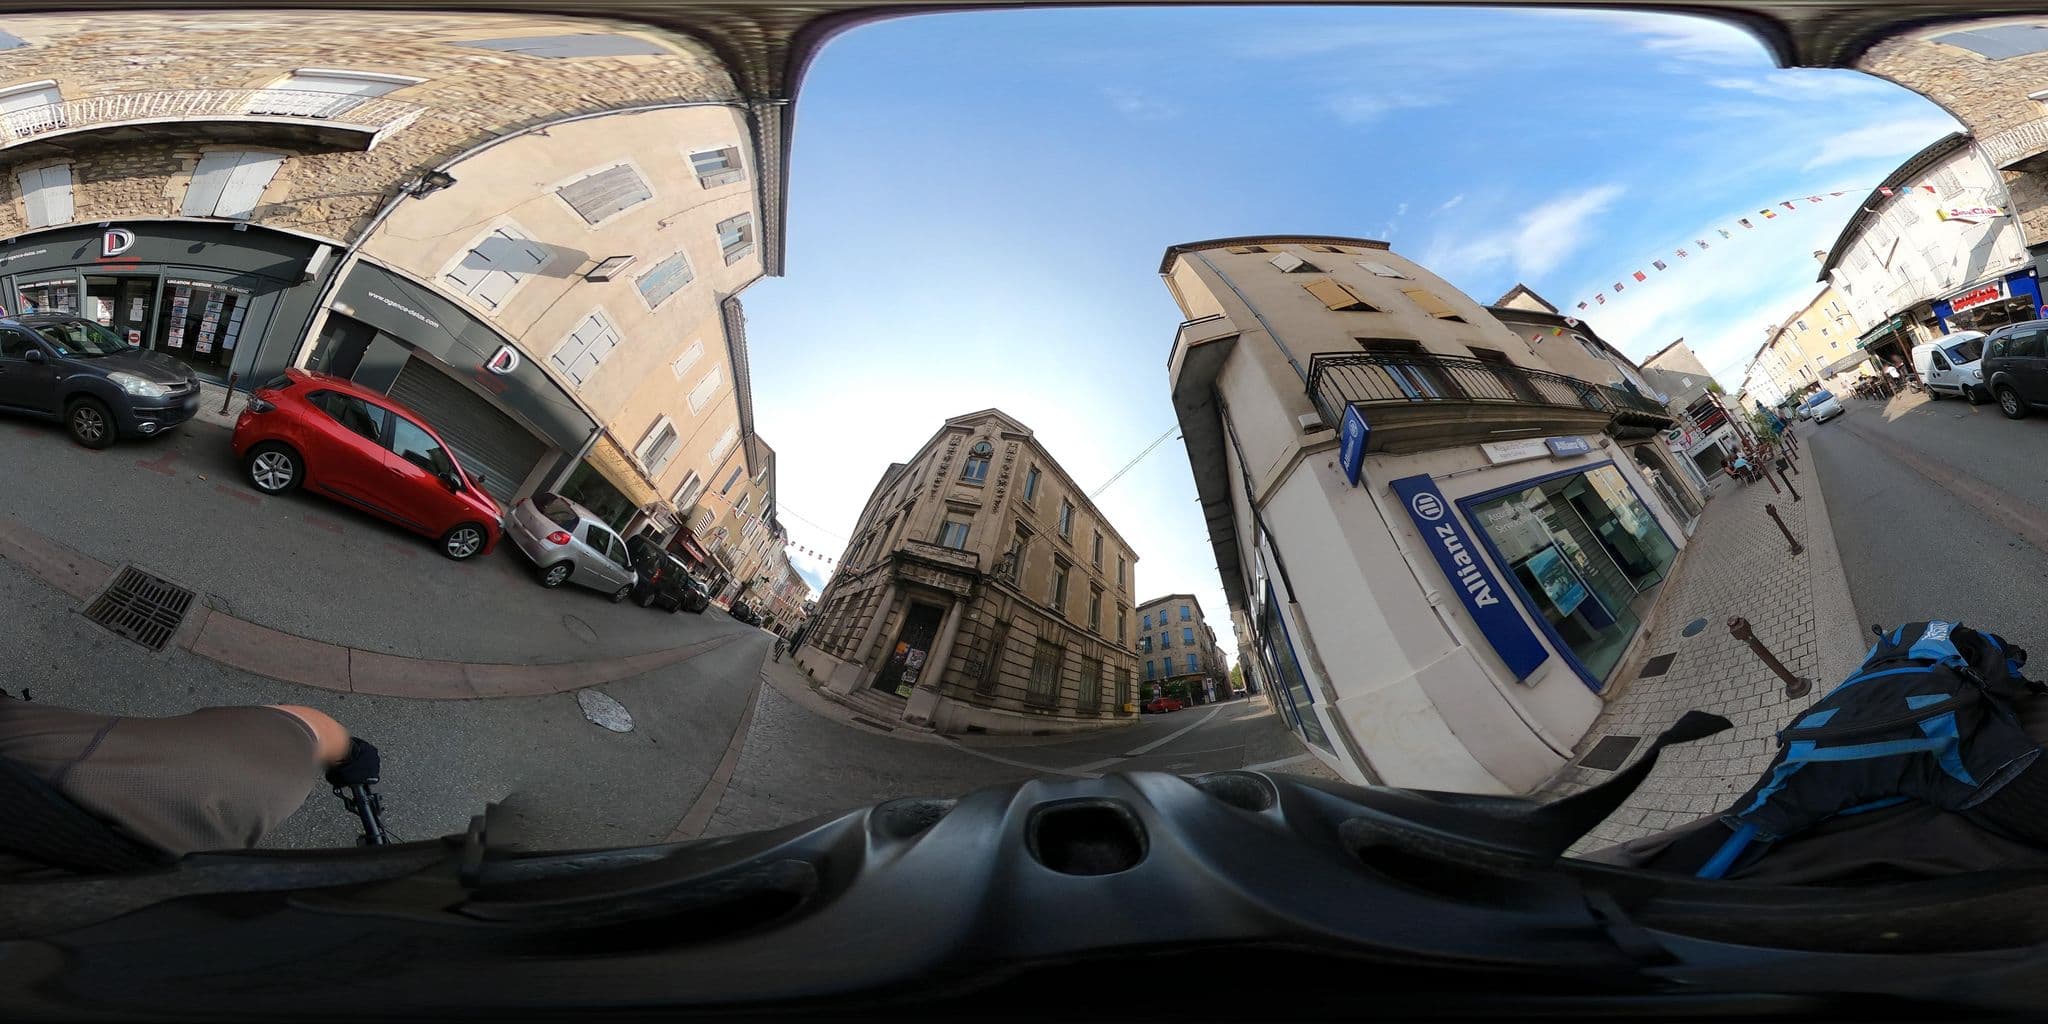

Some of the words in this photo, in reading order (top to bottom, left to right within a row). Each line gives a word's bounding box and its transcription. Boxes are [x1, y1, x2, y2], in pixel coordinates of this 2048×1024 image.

[102, 228, 136, 257] D
[486, 344, 520, 374] D
[1436, 523, 1499, 609] Allianz
